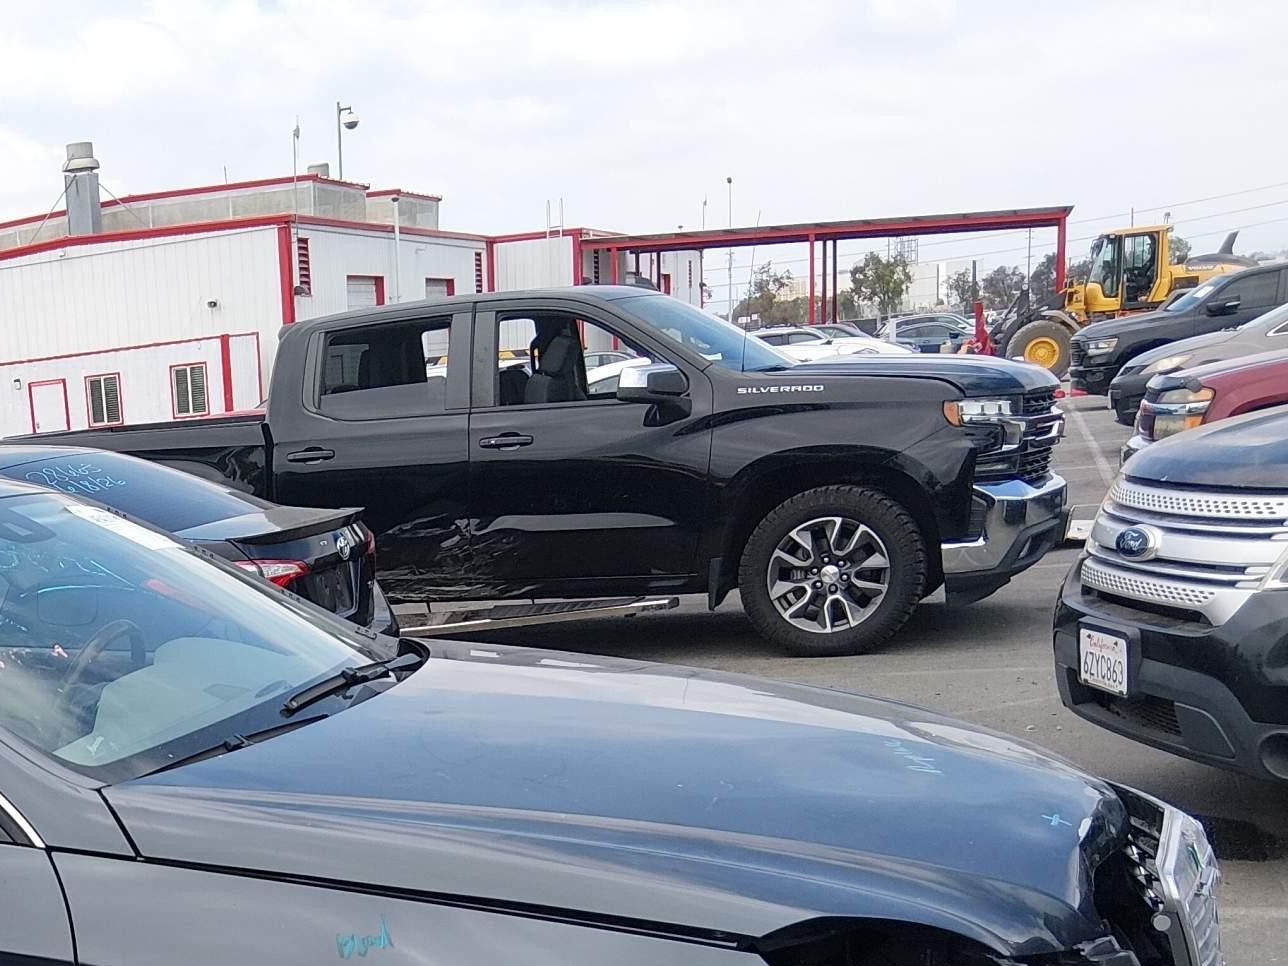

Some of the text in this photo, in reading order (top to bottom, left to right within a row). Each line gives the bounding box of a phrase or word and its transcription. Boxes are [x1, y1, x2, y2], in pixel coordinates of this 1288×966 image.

[736, 384, 825, 395] SILVERADO
[1117, 529, 1144, 551] Ford
[1083, 650, 1124, 685] 6ZYC863
